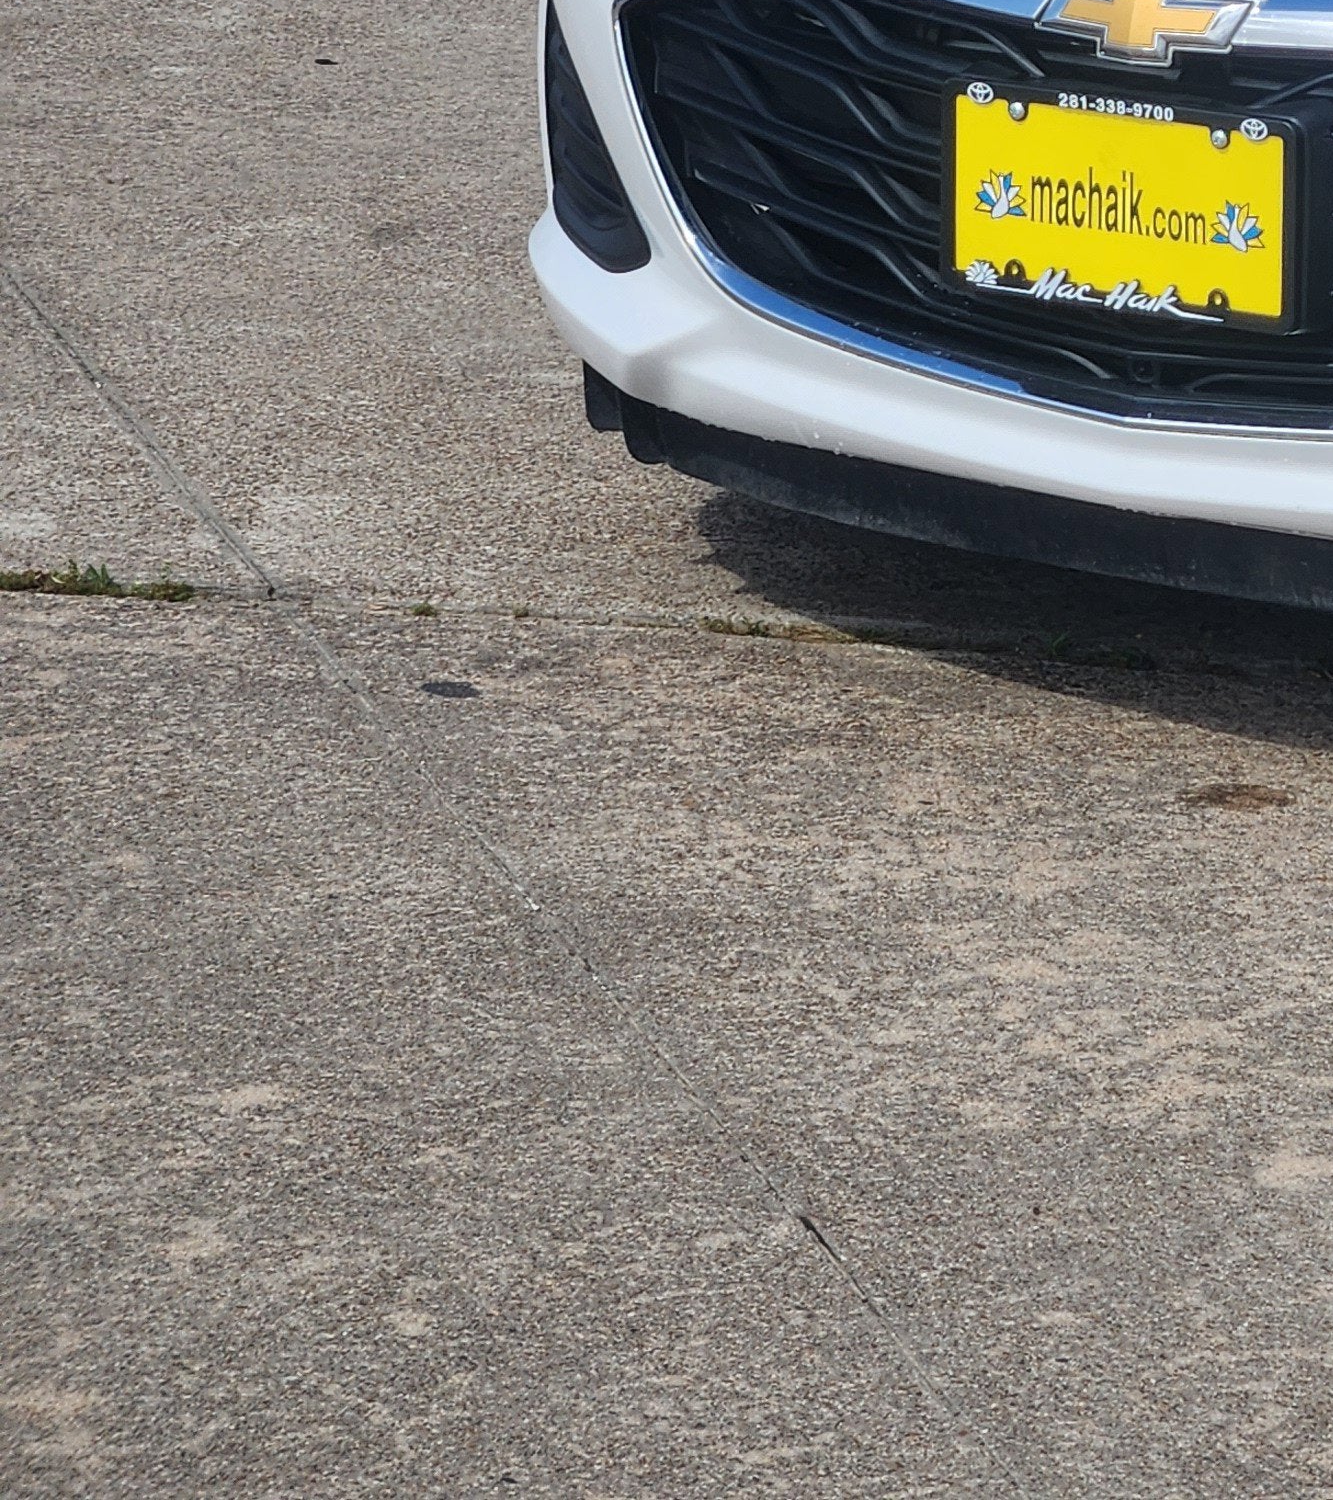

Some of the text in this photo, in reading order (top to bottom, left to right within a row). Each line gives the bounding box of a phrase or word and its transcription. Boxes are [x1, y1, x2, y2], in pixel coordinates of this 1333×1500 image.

[1057, 92, 1175, 122] 281-338-9700
[1030, 166, 1207, 245] machaik.com
[1029, 267, 1186, 314] Mac Haik
